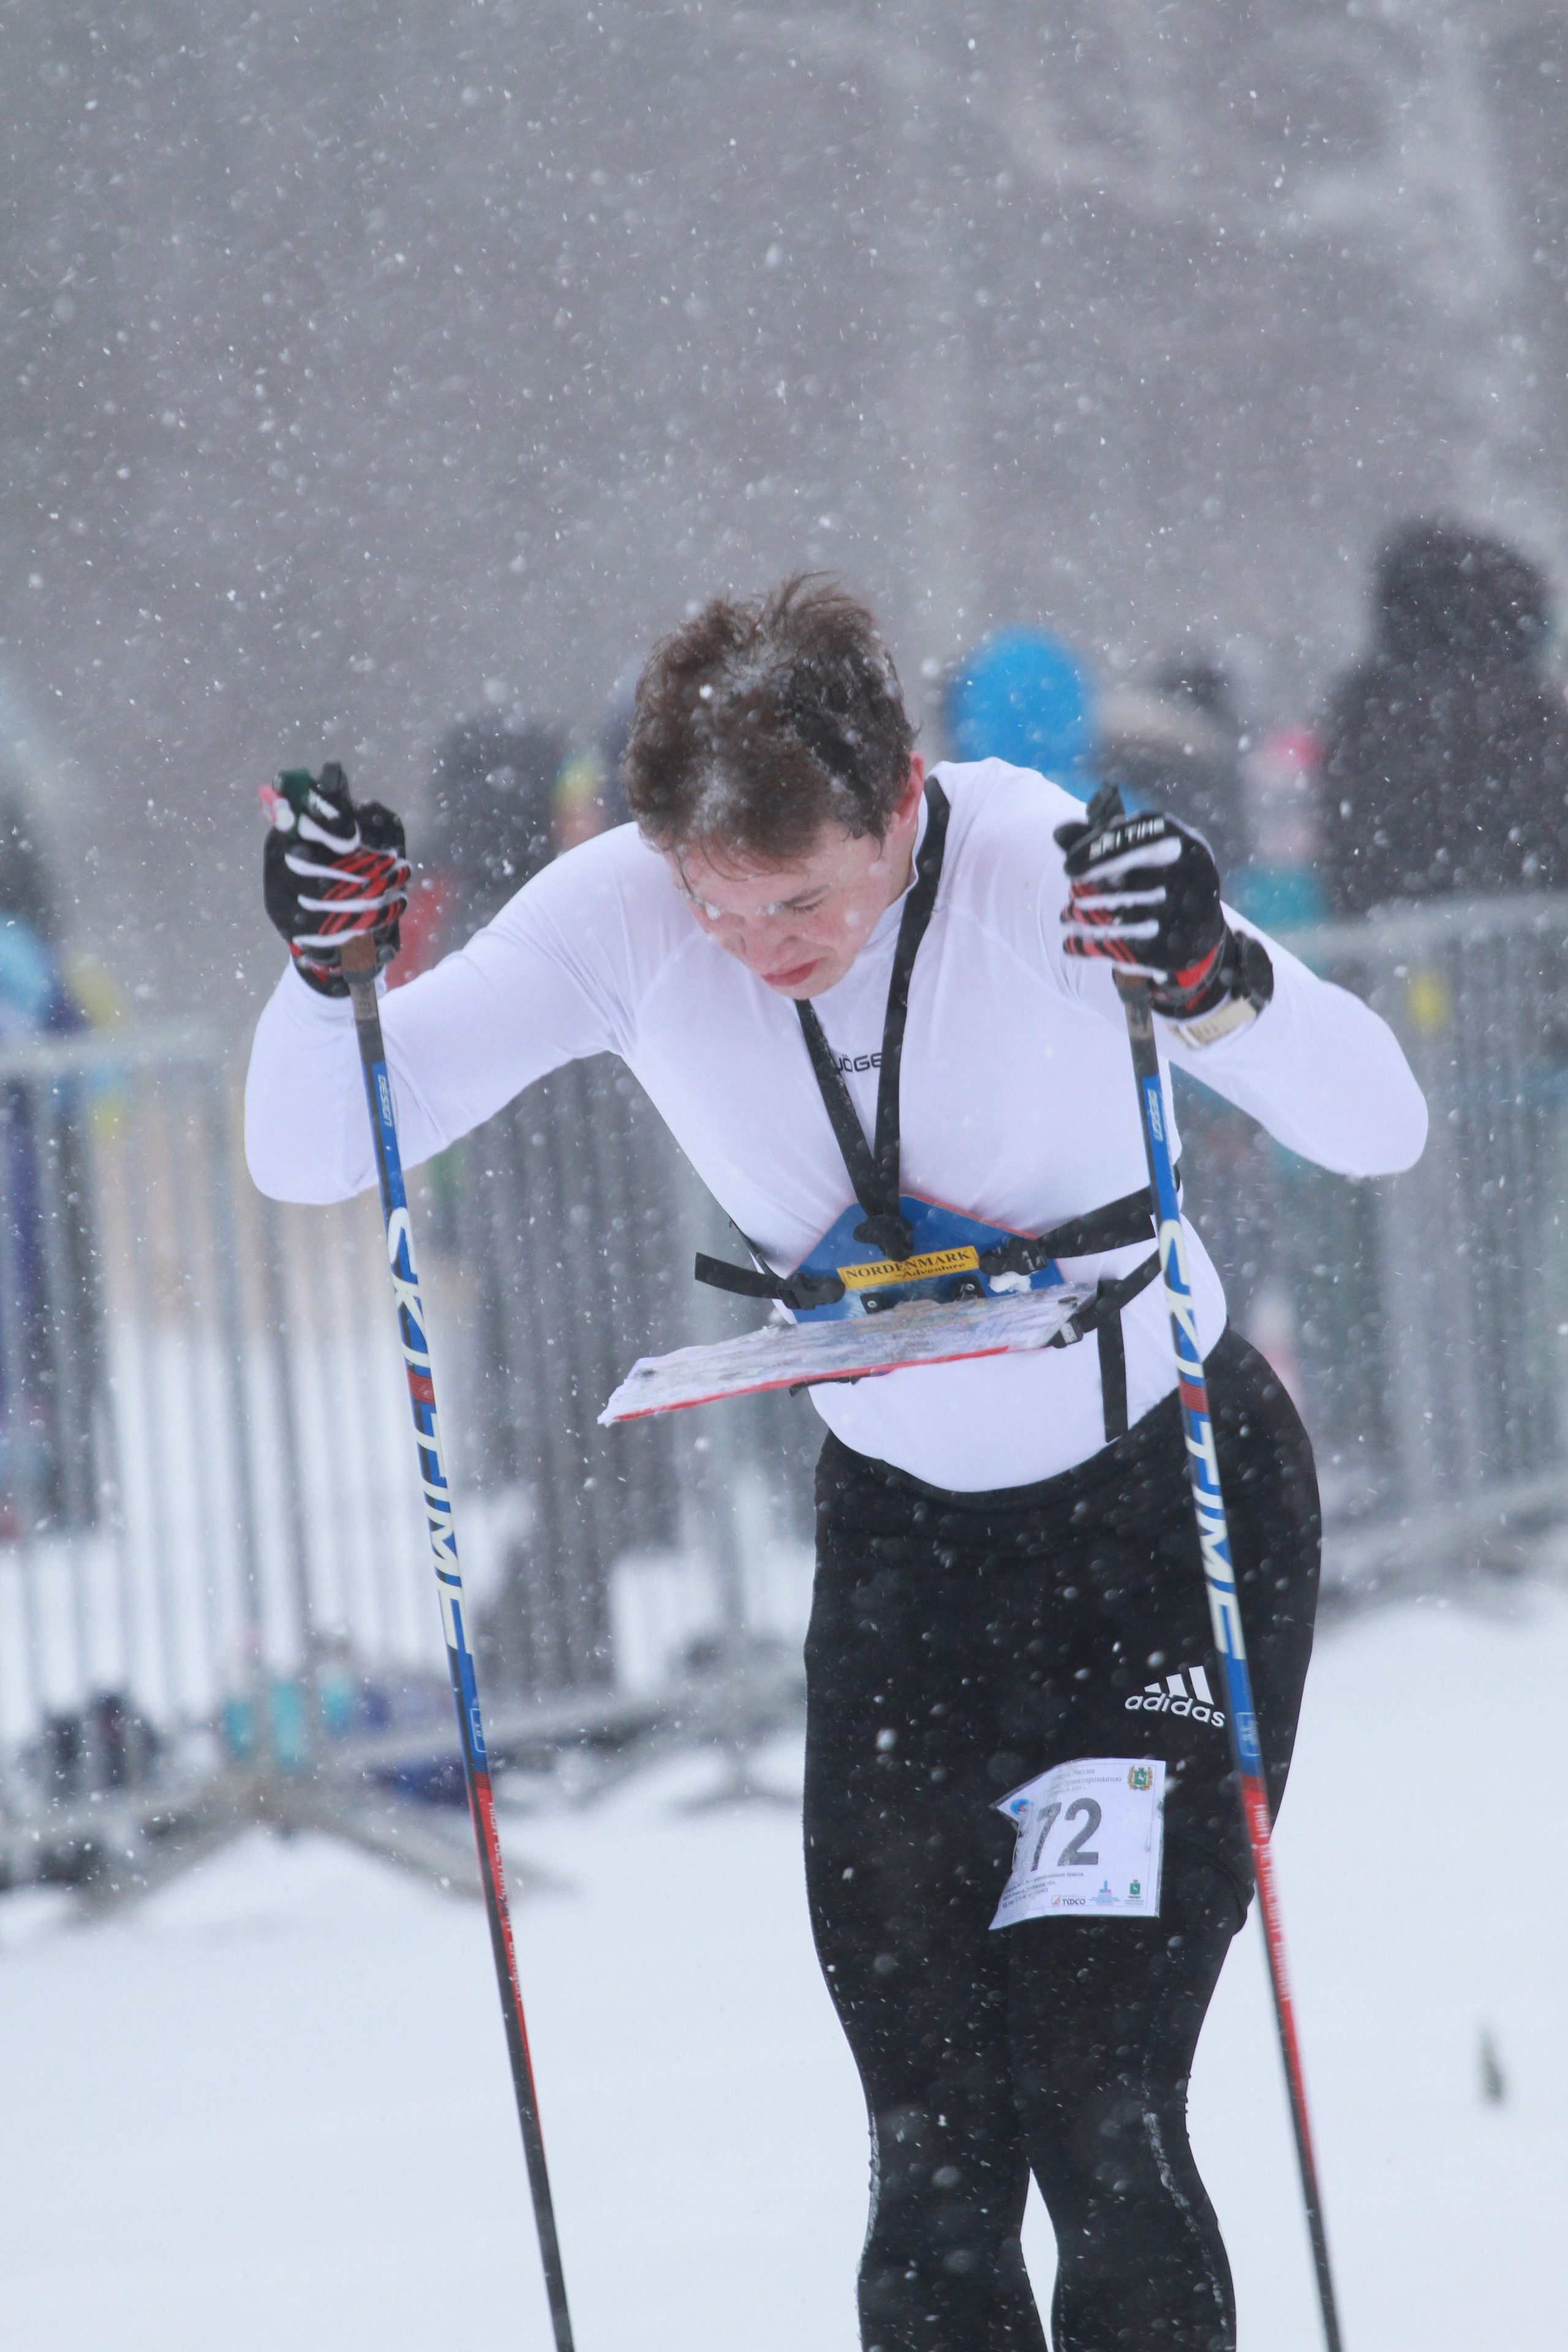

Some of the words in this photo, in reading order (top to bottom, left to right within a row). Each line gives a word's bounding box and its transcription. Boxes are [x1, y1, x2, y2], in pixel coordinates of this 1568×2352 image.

[377, 1074, 392, 1127] DESIGN
[845, 1250, 971, 1279] NORDENMARK
[902, 1262, 966, 1278] Adventure
[1125, 1693, 1225, 1727] adidas
[1030, 1797, 1102, 1872] 72
